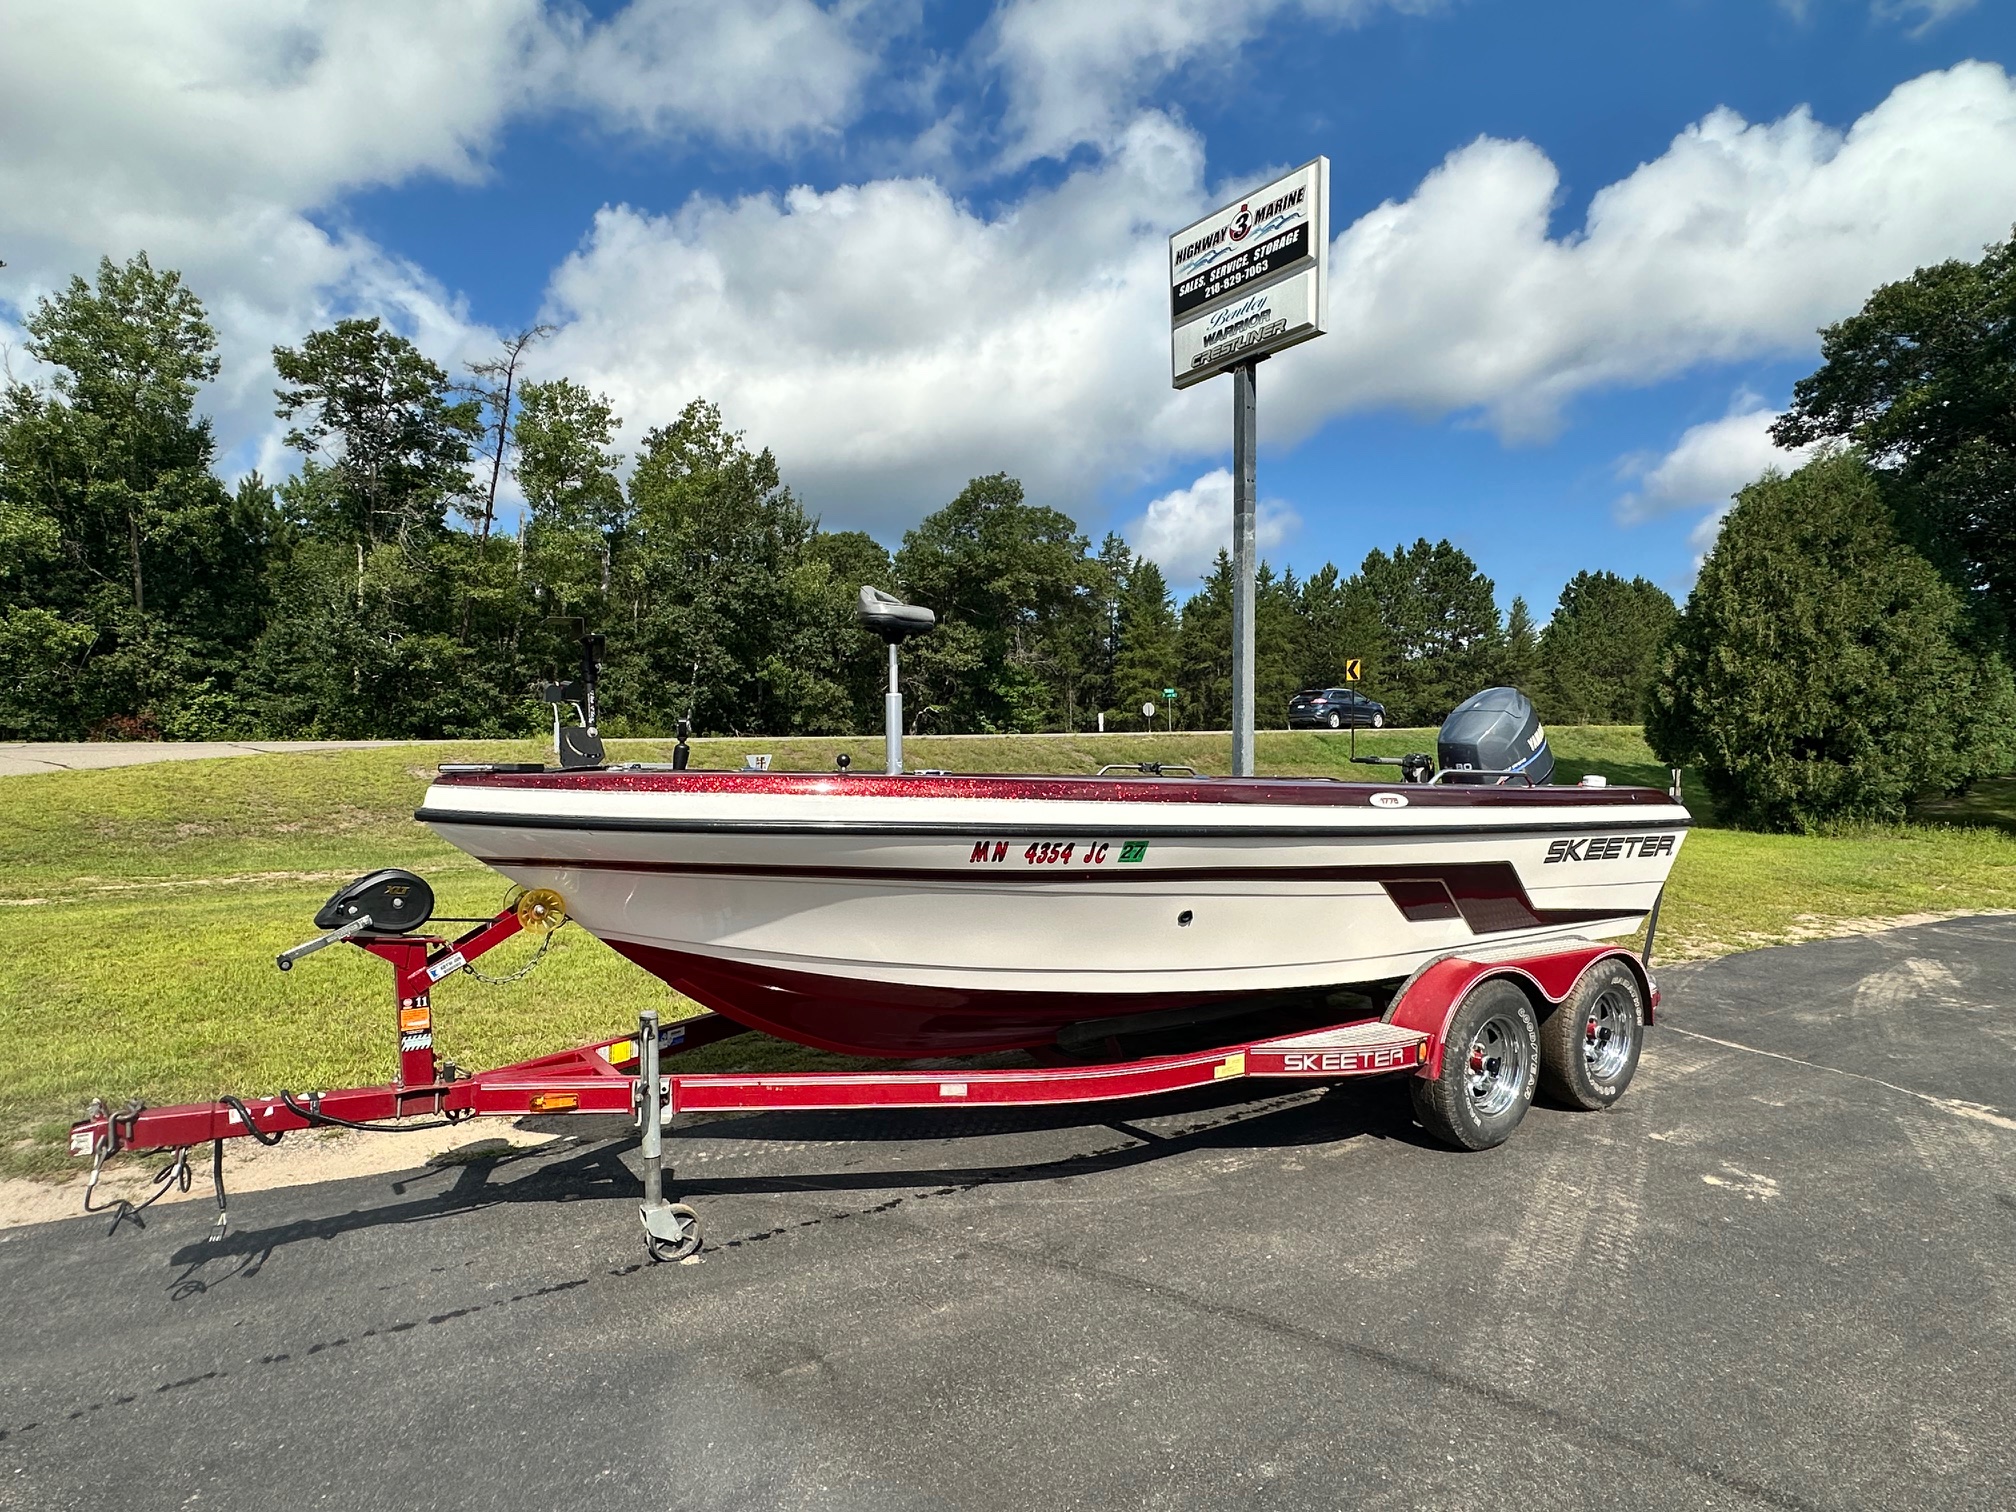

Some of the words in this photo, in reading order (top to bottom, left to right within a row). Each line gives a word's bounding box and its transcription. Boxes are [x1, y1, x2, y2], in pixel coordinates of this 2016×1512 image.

[1175, 226, 1229, 266] HIGHWAY
[1233, 213, 1249, 239] 3
[1253, 185, 1306, 226] MARINE
[1253, 229, 1300, 261] STORAGE
[1204, 260, 1269, 299] 218-829-7063
[1203, 308, 1271, 348] WARRIOR
[1206, 296, 1268, 331] Bentley
[1190, 318, 1287, 368] CRESTLINER
[1024, 842, 1076, 864] 4354
[1083, 841, 1110, 864] JC
[1120, 844, 1145, 859] 27
[1543, 835, 1676, 864] SKEETER
[1284, 1048, 1404, 1071] SKEETER
[1517, 1007, 1539, 1101] GOODYEAR
